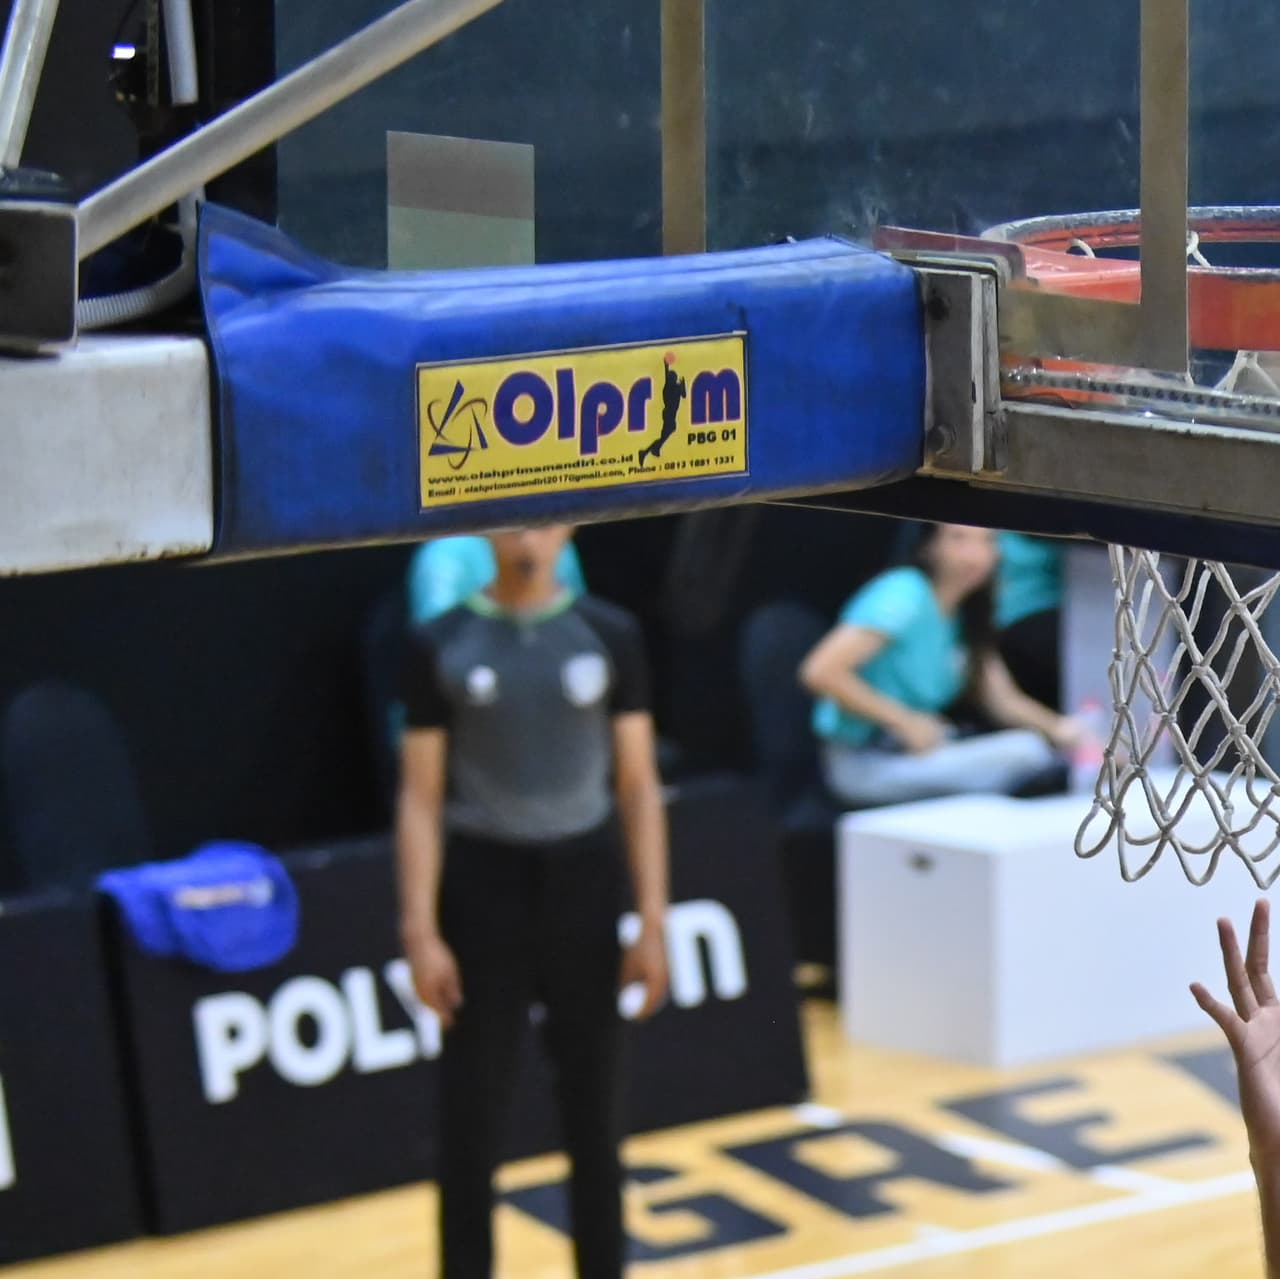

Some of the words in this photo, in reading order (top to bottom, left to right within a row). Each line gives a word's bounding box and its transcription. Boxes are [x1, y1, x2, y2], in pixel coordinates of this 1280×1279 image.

[687, 431, 718, 446] PBG
[721, 428, 737, 442] 01
[428, 486, 456, 498] Email
